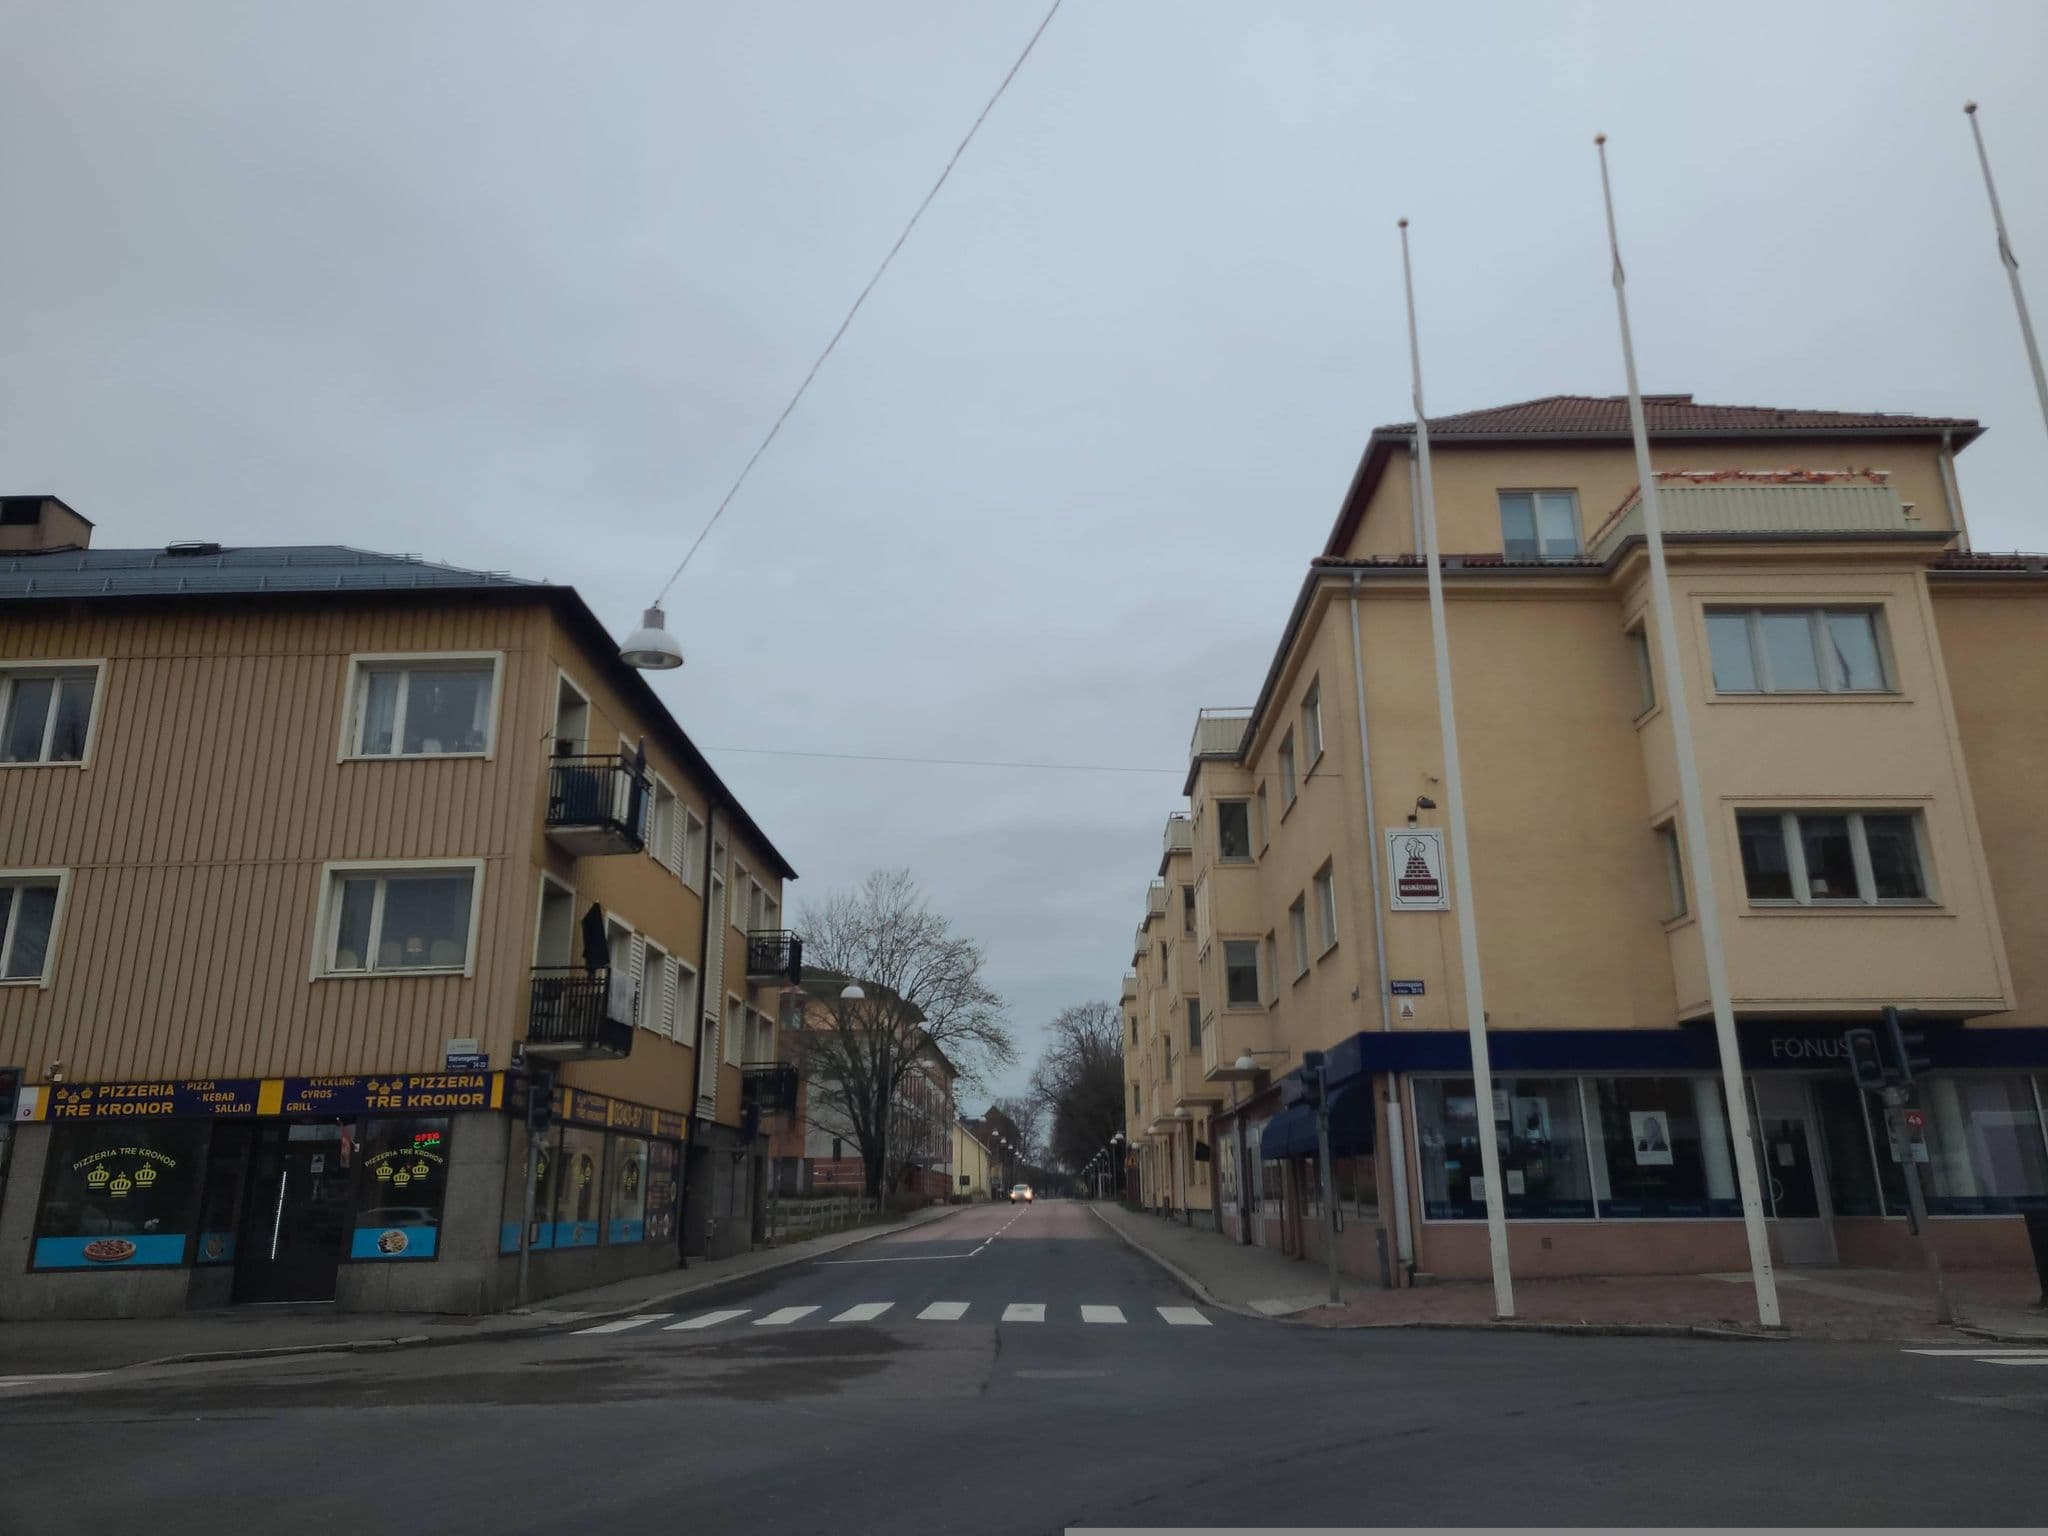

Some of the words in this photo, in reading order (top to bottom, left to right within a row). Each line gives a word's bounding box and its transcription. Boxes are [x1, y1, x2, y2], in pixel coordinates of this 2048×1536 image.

[1771, 1037, 1850, 1058] FONUS
[186, 1081, 215, 1091] PIZZA
[310, 1078, 356, 1087] KYCKLING
[409, 1075, 485, 1089] PIZZERIA
[98, 1084, 175, 1098] PIZZERIA
[202, 1092, 235, 1102] KEBAB
[301, 1089, 333, 1099] GYROS
[215, 1103, 251, 1113] SALLAD
[286, 1102, 312, 1112] GRILL
[365, 1096, 402, 1109] TRE
[407, 1093, 485, 1107] KRONOR
[54, 1103, 91, 1117] TRE
[96, 1102, 174, 1116] KRONOR
[73, 1149, 117, 1171] PIZZERIA
[119, 1147, 138, 1156] TRE
[139, 1148, 176, 1169] KRONOR
[365, 1150, 398, 1168] PIZZERIA
[414, 1149, 444, 1165] KRONOR
